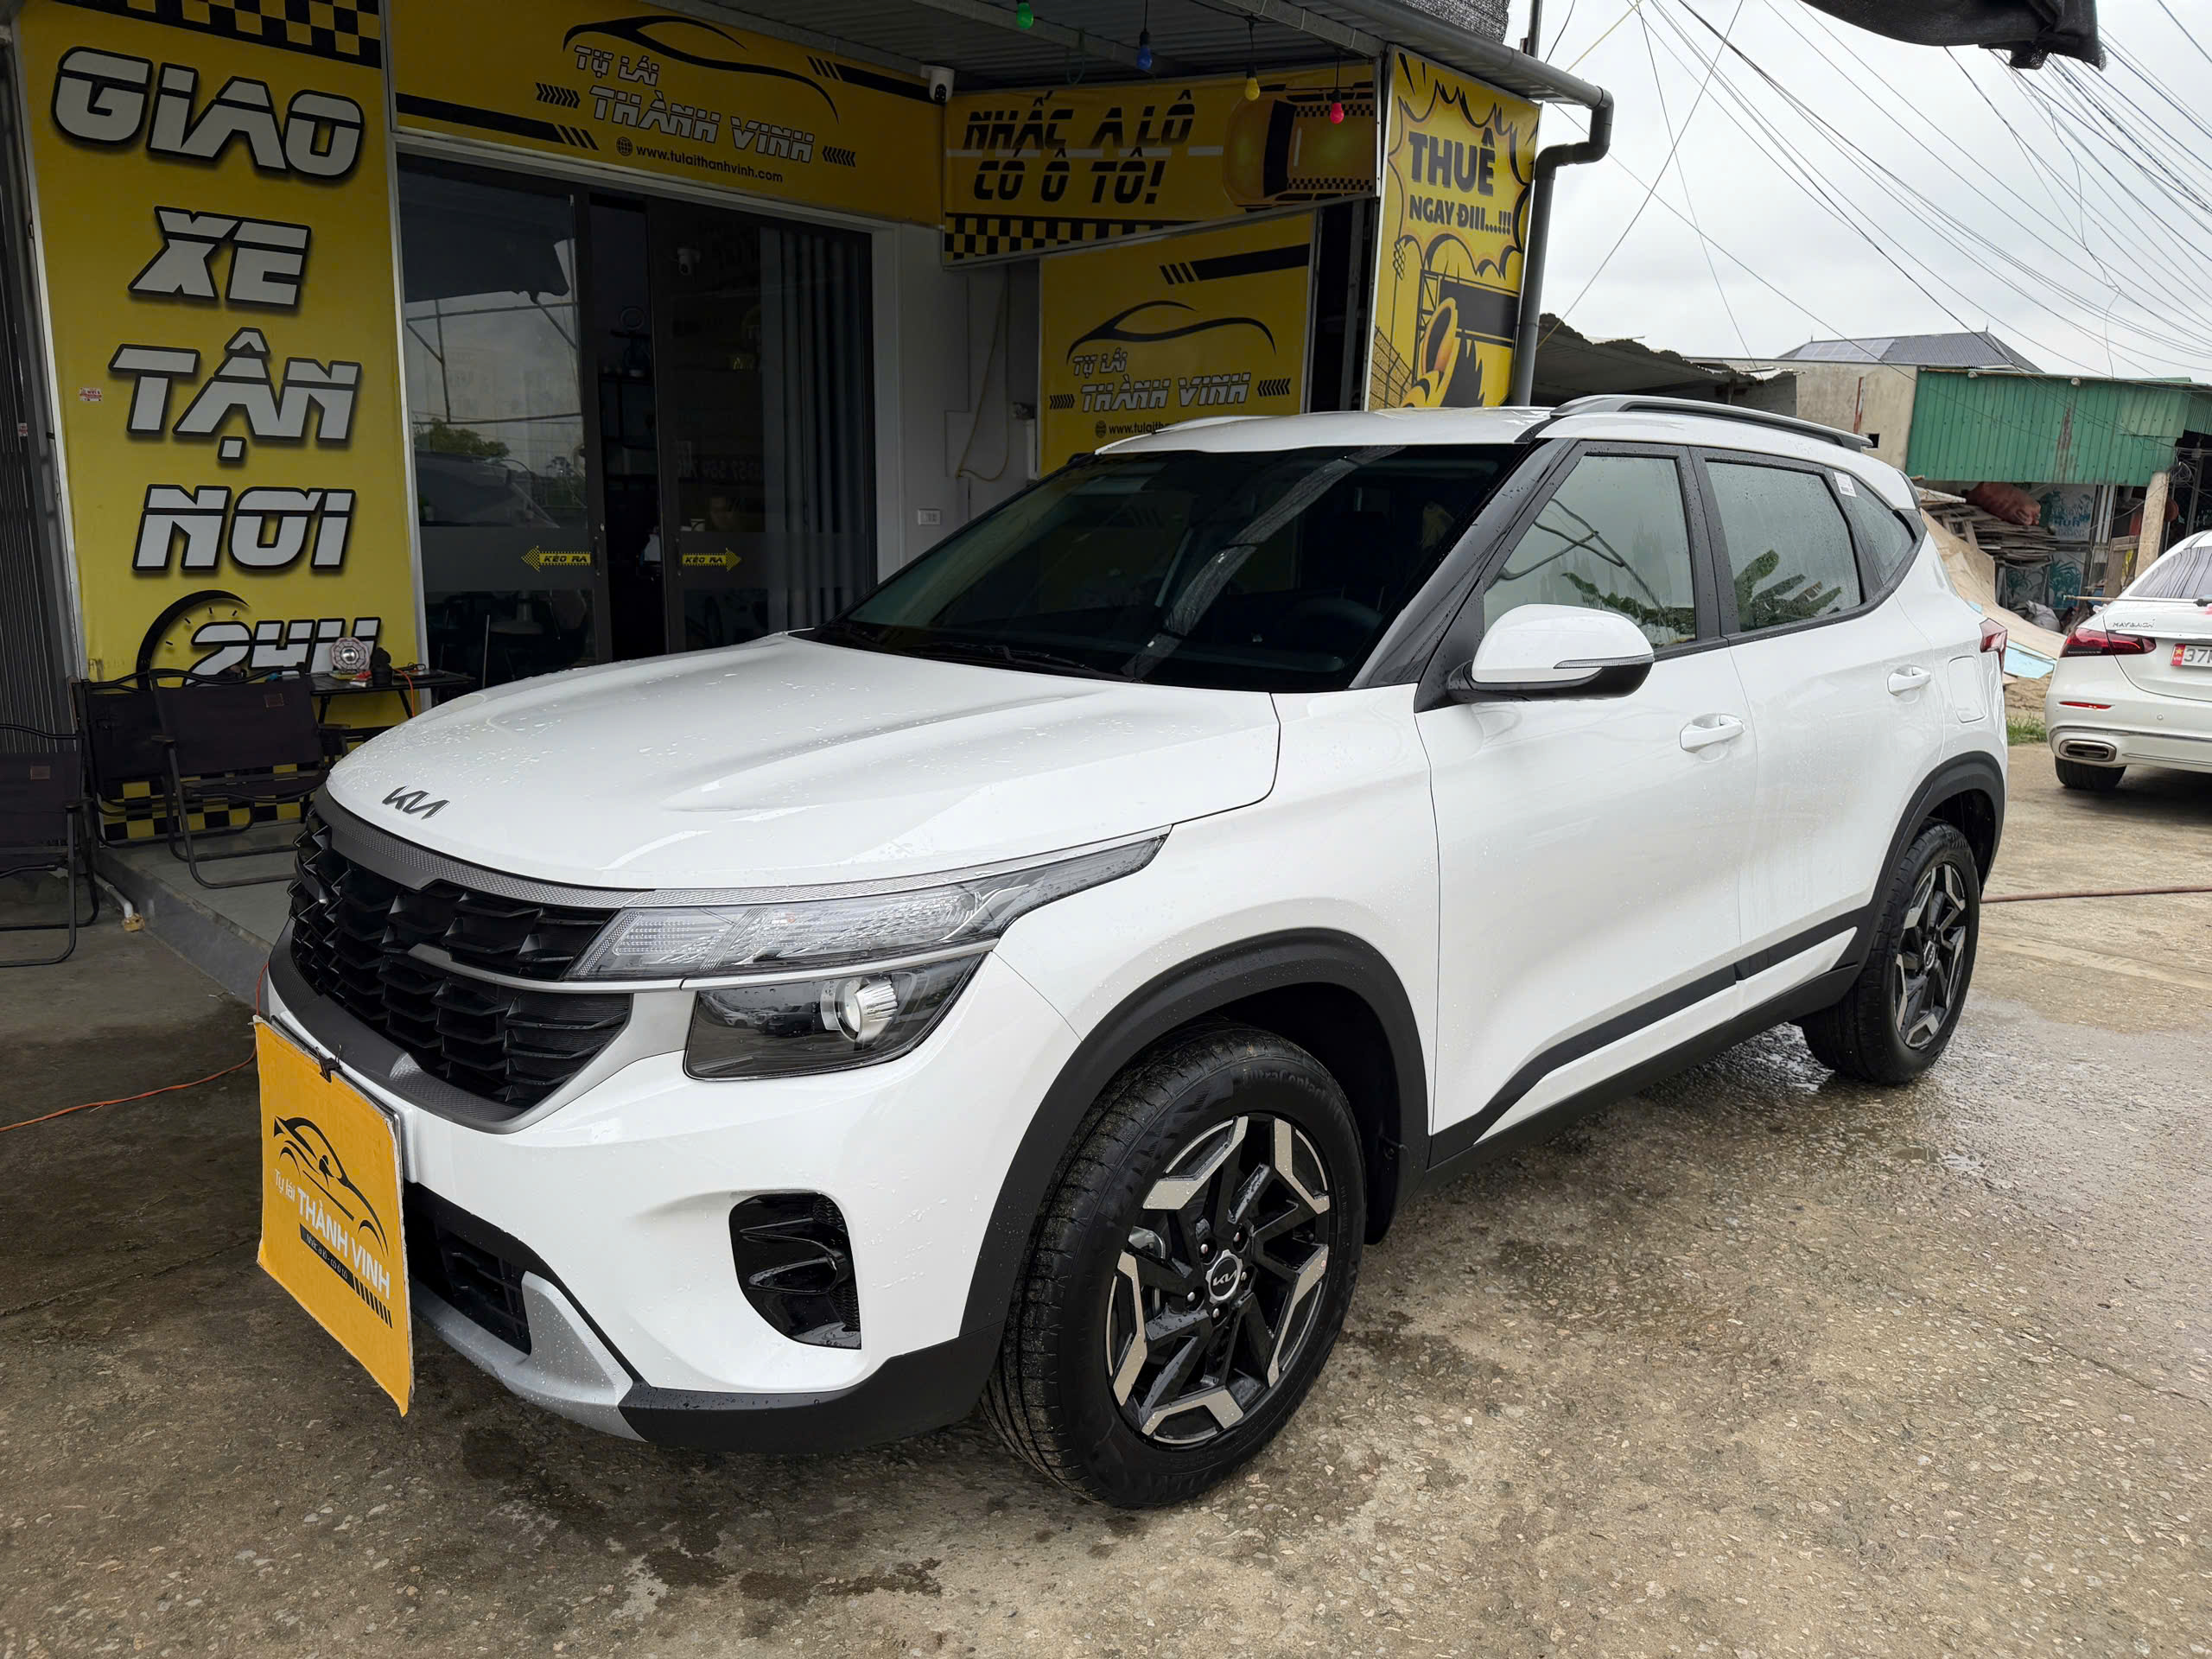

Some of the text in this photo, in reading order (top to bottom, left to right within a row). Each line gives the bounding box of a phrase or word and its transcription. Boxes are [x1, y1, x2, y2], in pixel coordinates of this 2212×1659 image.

[618, 55, 660, 86] LÁI
[51, 46, 364, 178] GIAO
[588, 85, 817, 163] THÀNH VINH
[962, 89, 1196, 150] NHẤC A LÔ
[636, 143, 784, 182] www.tulaithanhvinh.com
[973, 146, 1166, 204] CÓ Ô TÔ!
[1408, 127, 1497, 197] THUÊ
[1408, 194, 1455, 225] NGAY
[128, 206, 312, 308] XE
[1080, 372, 1251, 413] THÀNH VINH
[1099, 347, 1128, 374] LÁI
[108, 327, 362, 461] TẬN
[132, 484, 357, 570] NƠI
[297, 1186, 349, 1259] THÀNH
[353, 1236, 391, 1300] VINH
